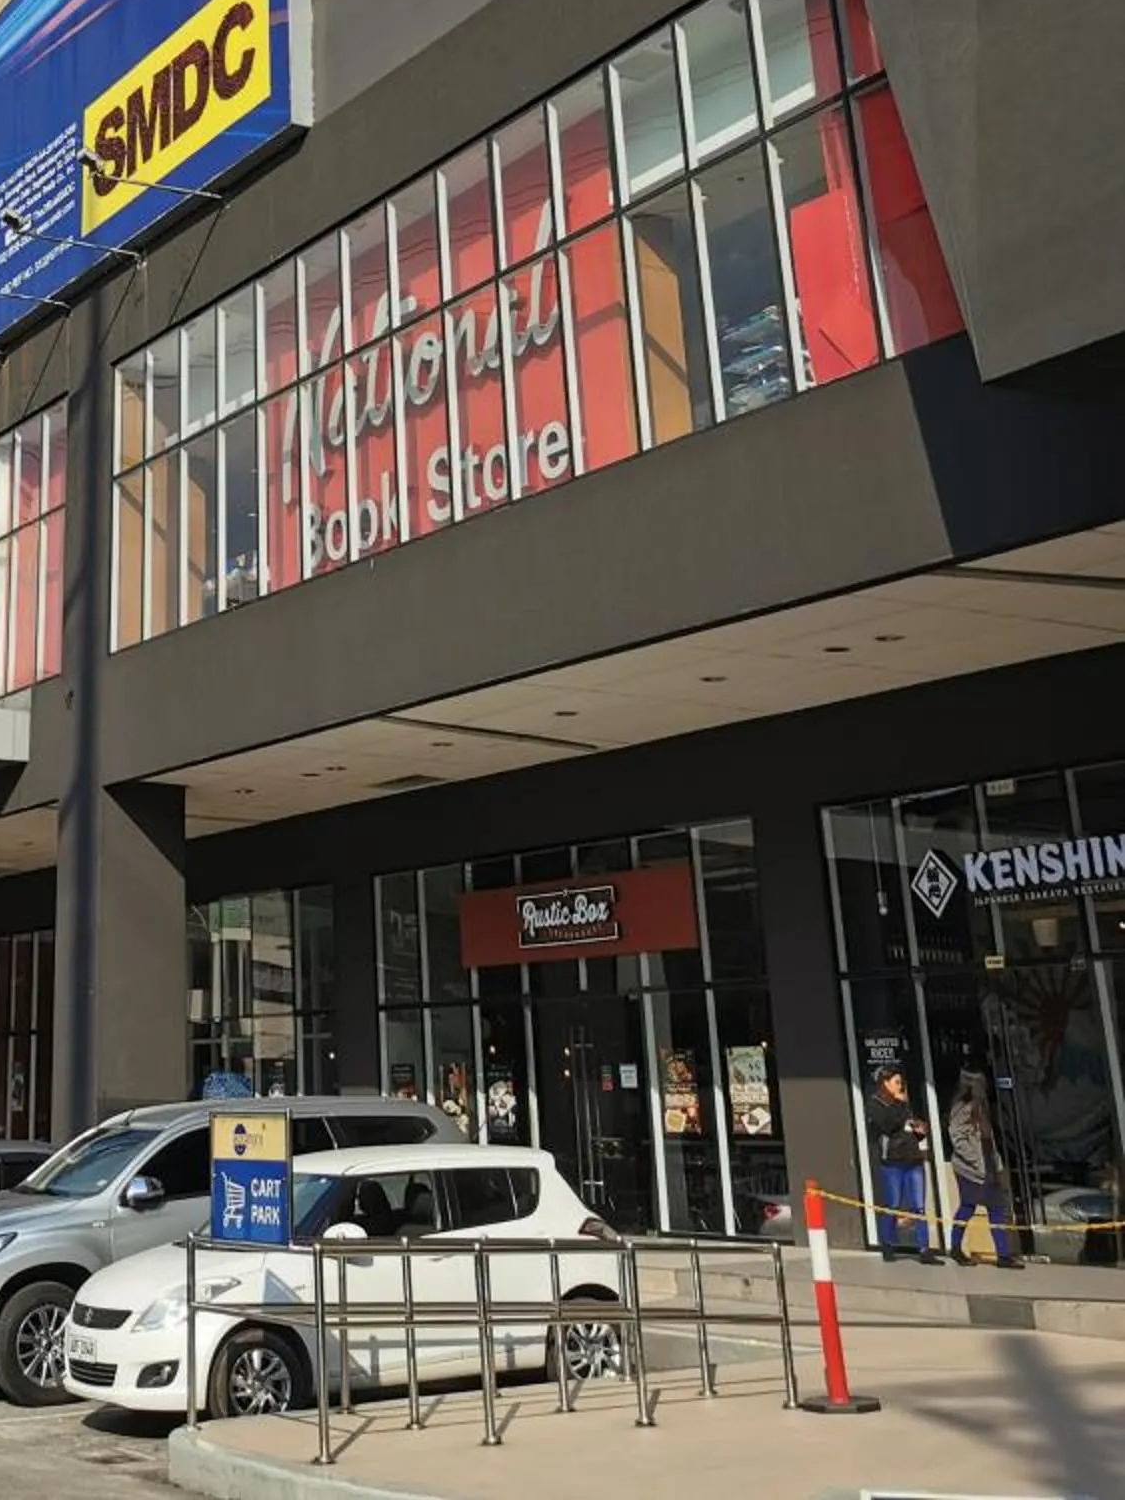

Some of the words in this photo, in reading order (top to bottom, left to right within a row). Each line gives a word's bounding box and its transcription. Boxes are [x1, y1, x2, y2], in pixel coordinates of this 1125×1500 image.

[93, 1, 256, 197] SMDC
[282, 198, 560, 505] Natonal
[304, 470, 399, 568] Book
[426, 420, 570, 523] Store
[522, 901, 571, 937] Rustic
[572, 894, 610, 924] Box
[250, 1179, 282, 1197] CART
[250, 1205, 280, 1226] PARK
